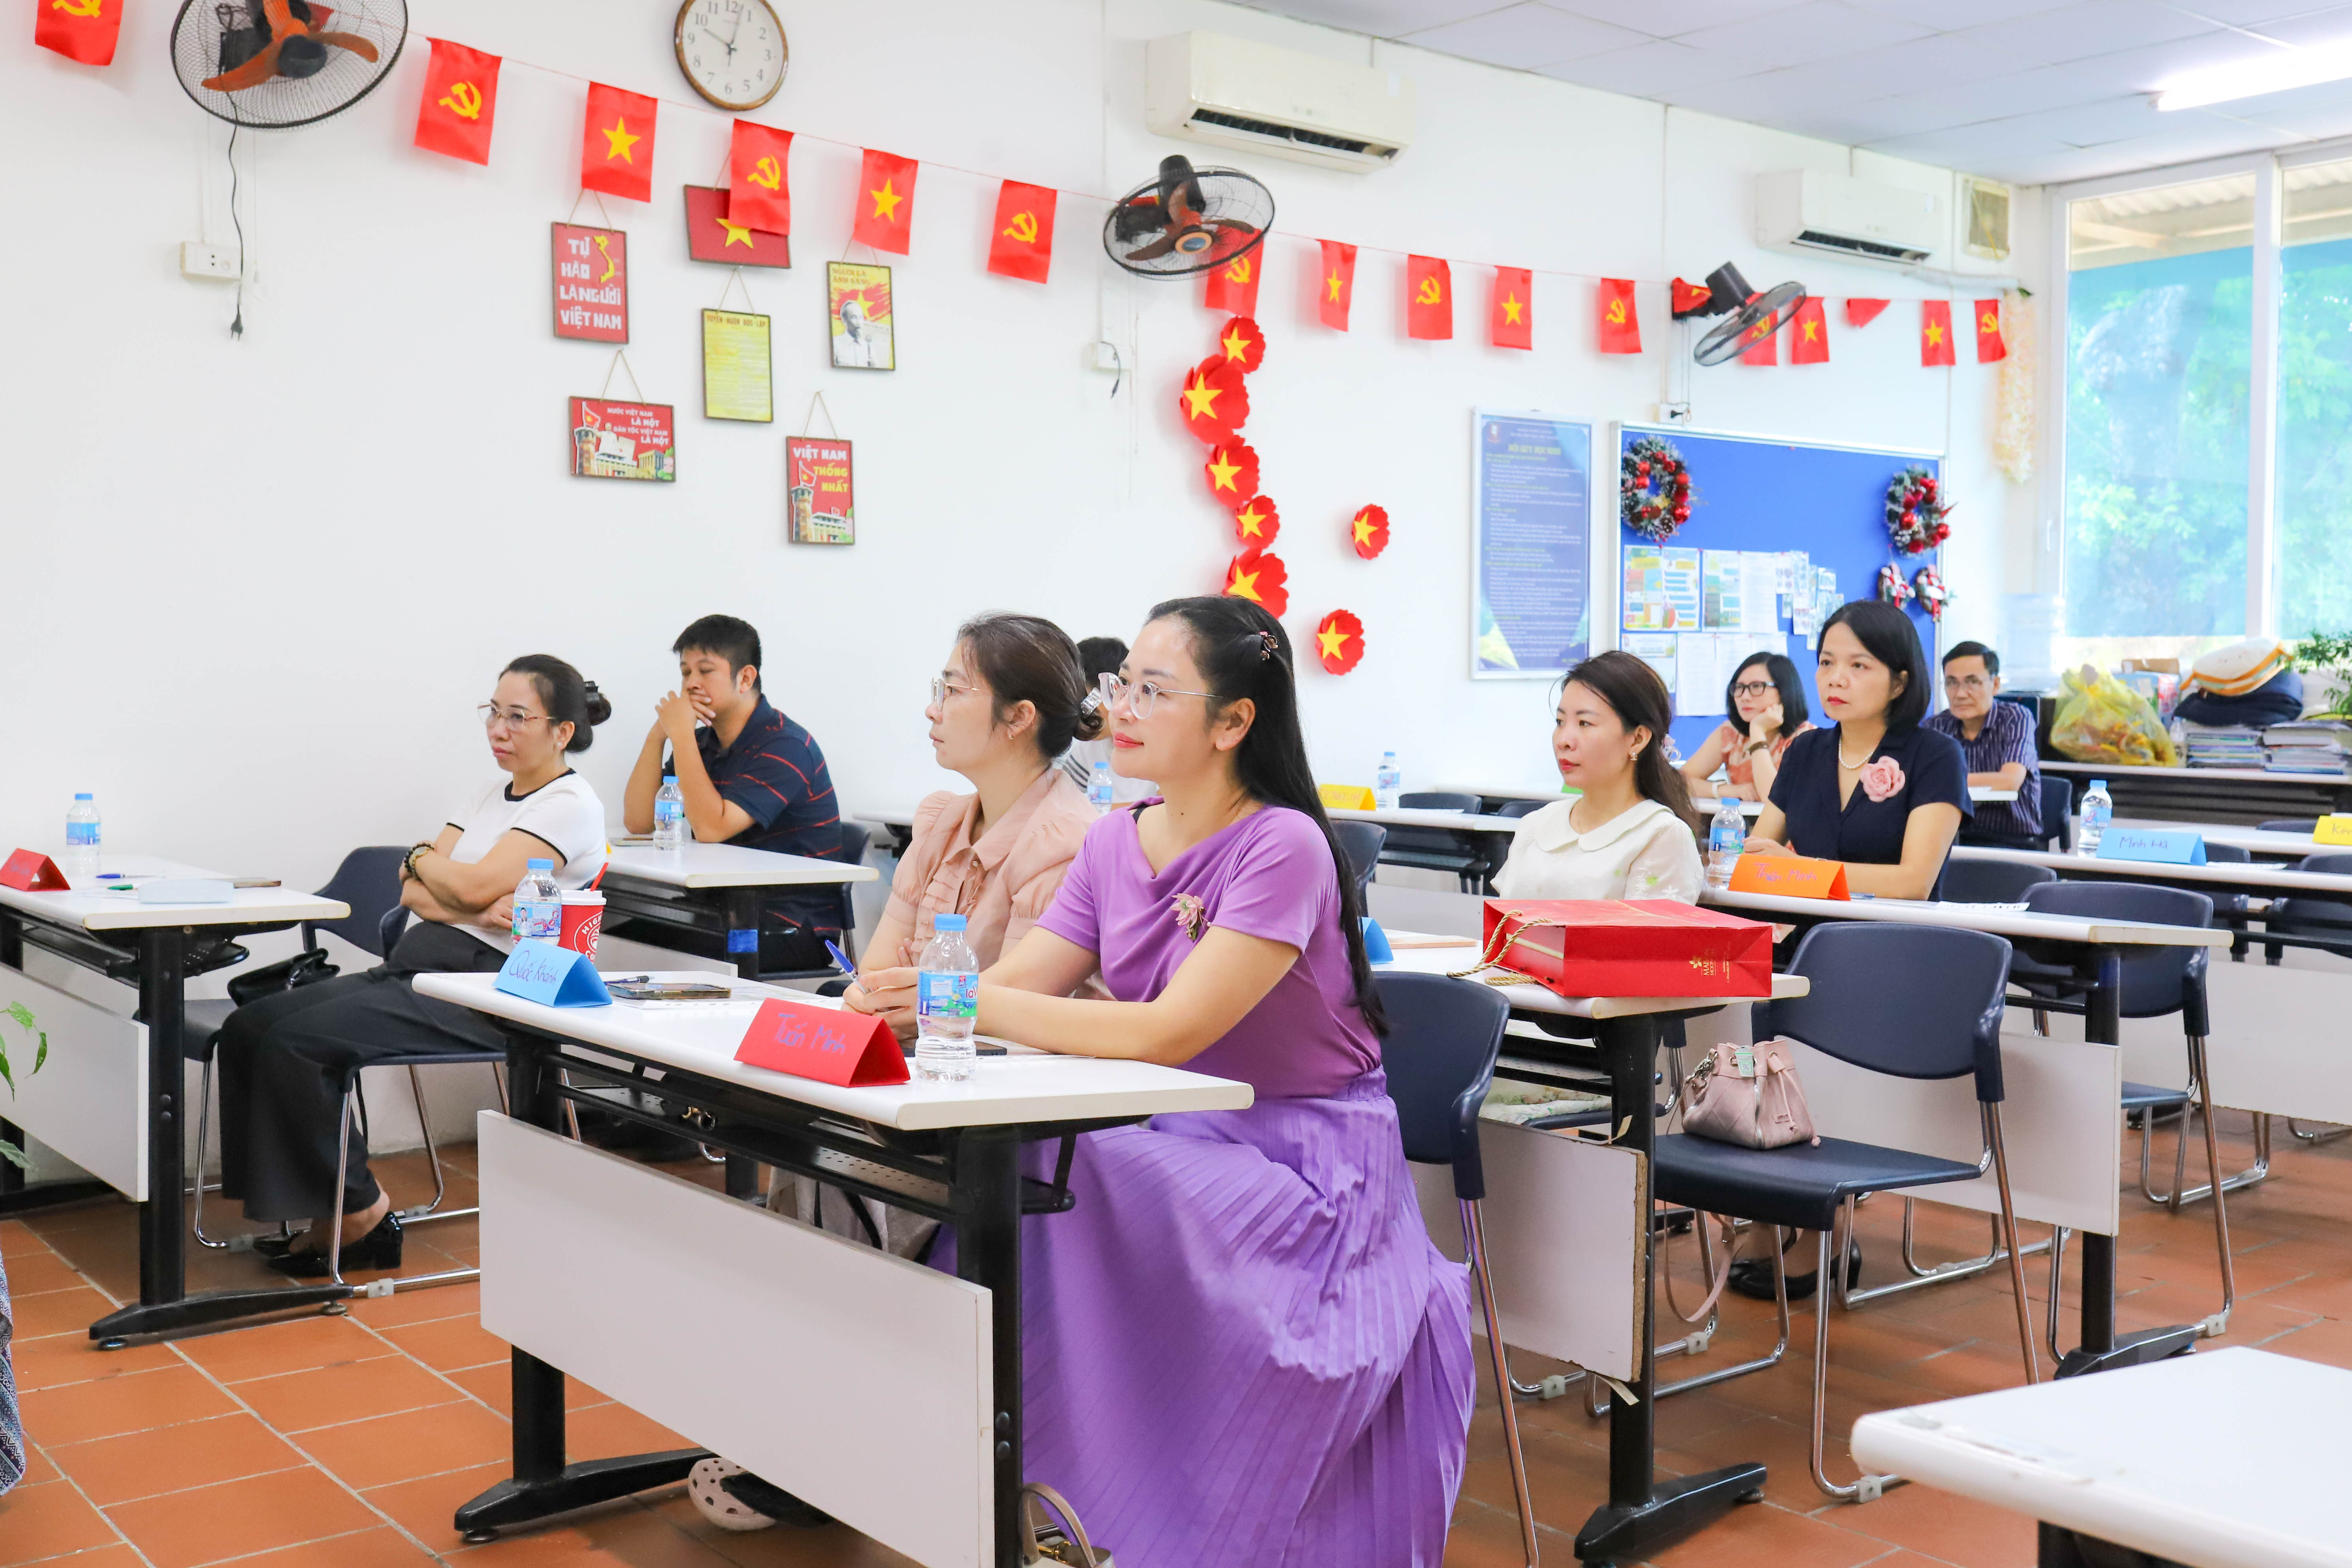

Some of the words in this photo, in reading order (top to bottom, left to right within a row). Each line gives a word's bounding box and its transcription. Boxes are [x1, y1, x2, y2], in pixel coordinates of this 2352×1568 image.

[708, 1, 718, 14] 11
[726, 0, 738, 13] 12
[695, 13, 708, 26] 10
[747, 10, 751, 22] 1
[688, 33, 695, 44] 9
[759, 27, 766, 39] 2
[764, 49, 771, 60] 3
[693, 55, 701, 67] 8
[707, 72, 714, 83] 7
[757, 69, 763, 81] 4
[725, 82, 732, 94] 6
[743, 79, 750, 92] 5
[568, 236, 591, 258] TỰ
[561, 260, 590, 279] HÀO
[560, 306, 591, 329] VIỆT
[594, 313, 622, 330] NAM
[631, 416, 641, 426] LÀ
[643, 418, 659, 428] MỘT
[652, 436, 669, 447] MỘT
[793, 444, 819, 462] VIỆT
[821, 449, 847, 461] NAM
[813, 462, 848, 477] THỐNG
[821, 479, 849, 492] NHẤT
